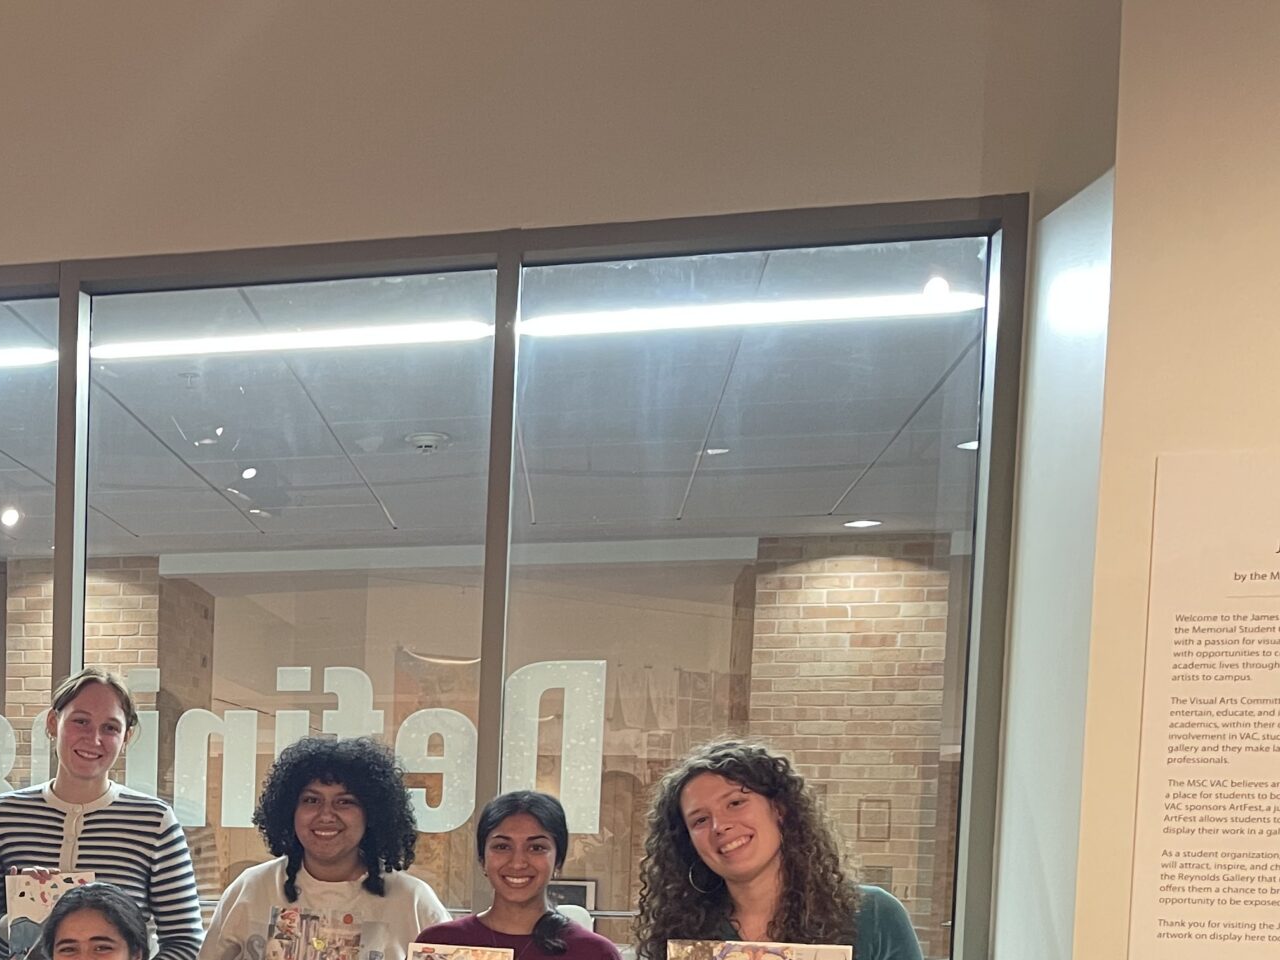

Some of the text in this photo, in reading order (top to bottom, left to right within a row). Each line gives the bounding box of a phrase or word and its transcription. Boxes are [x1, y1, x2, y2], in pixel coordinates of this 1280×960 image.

[1234, 572, 1247, 582] by
[1250, 572, 1267, 580] the
[1176, 614, 1218, 622] Welcome
[1205, 639, 1239, 647] passion
[1196, 650, 1259, 659] opportunities
[1168, 745, 1198, 753] gallery
[1222, 745, 1242, 753] they
[1167, 756, 1229, 764] professionals.
[1168, 779, 1184, 787] The
[1231, 780, 1268, 788] believes
[1173, 792, 1197, 800] place
[1200, 791, 1212, 799] for
[1185, 804, 1226, 812] sponsors
[1163, 826, 1195, 835] display
[1179, 862, 1211, 870] attract,
[1222, 874, 1255, 883] Gallery
[1160, 884, 1185, 892] offers
[1159, 896, 1214, 906] opportunity
[1158, 919, 1185, 927] Thank
[1208, 920, 1220, 928] for
[1223, 921, 1256, 930] visiting
[1210, 933, 1242, 942] display
